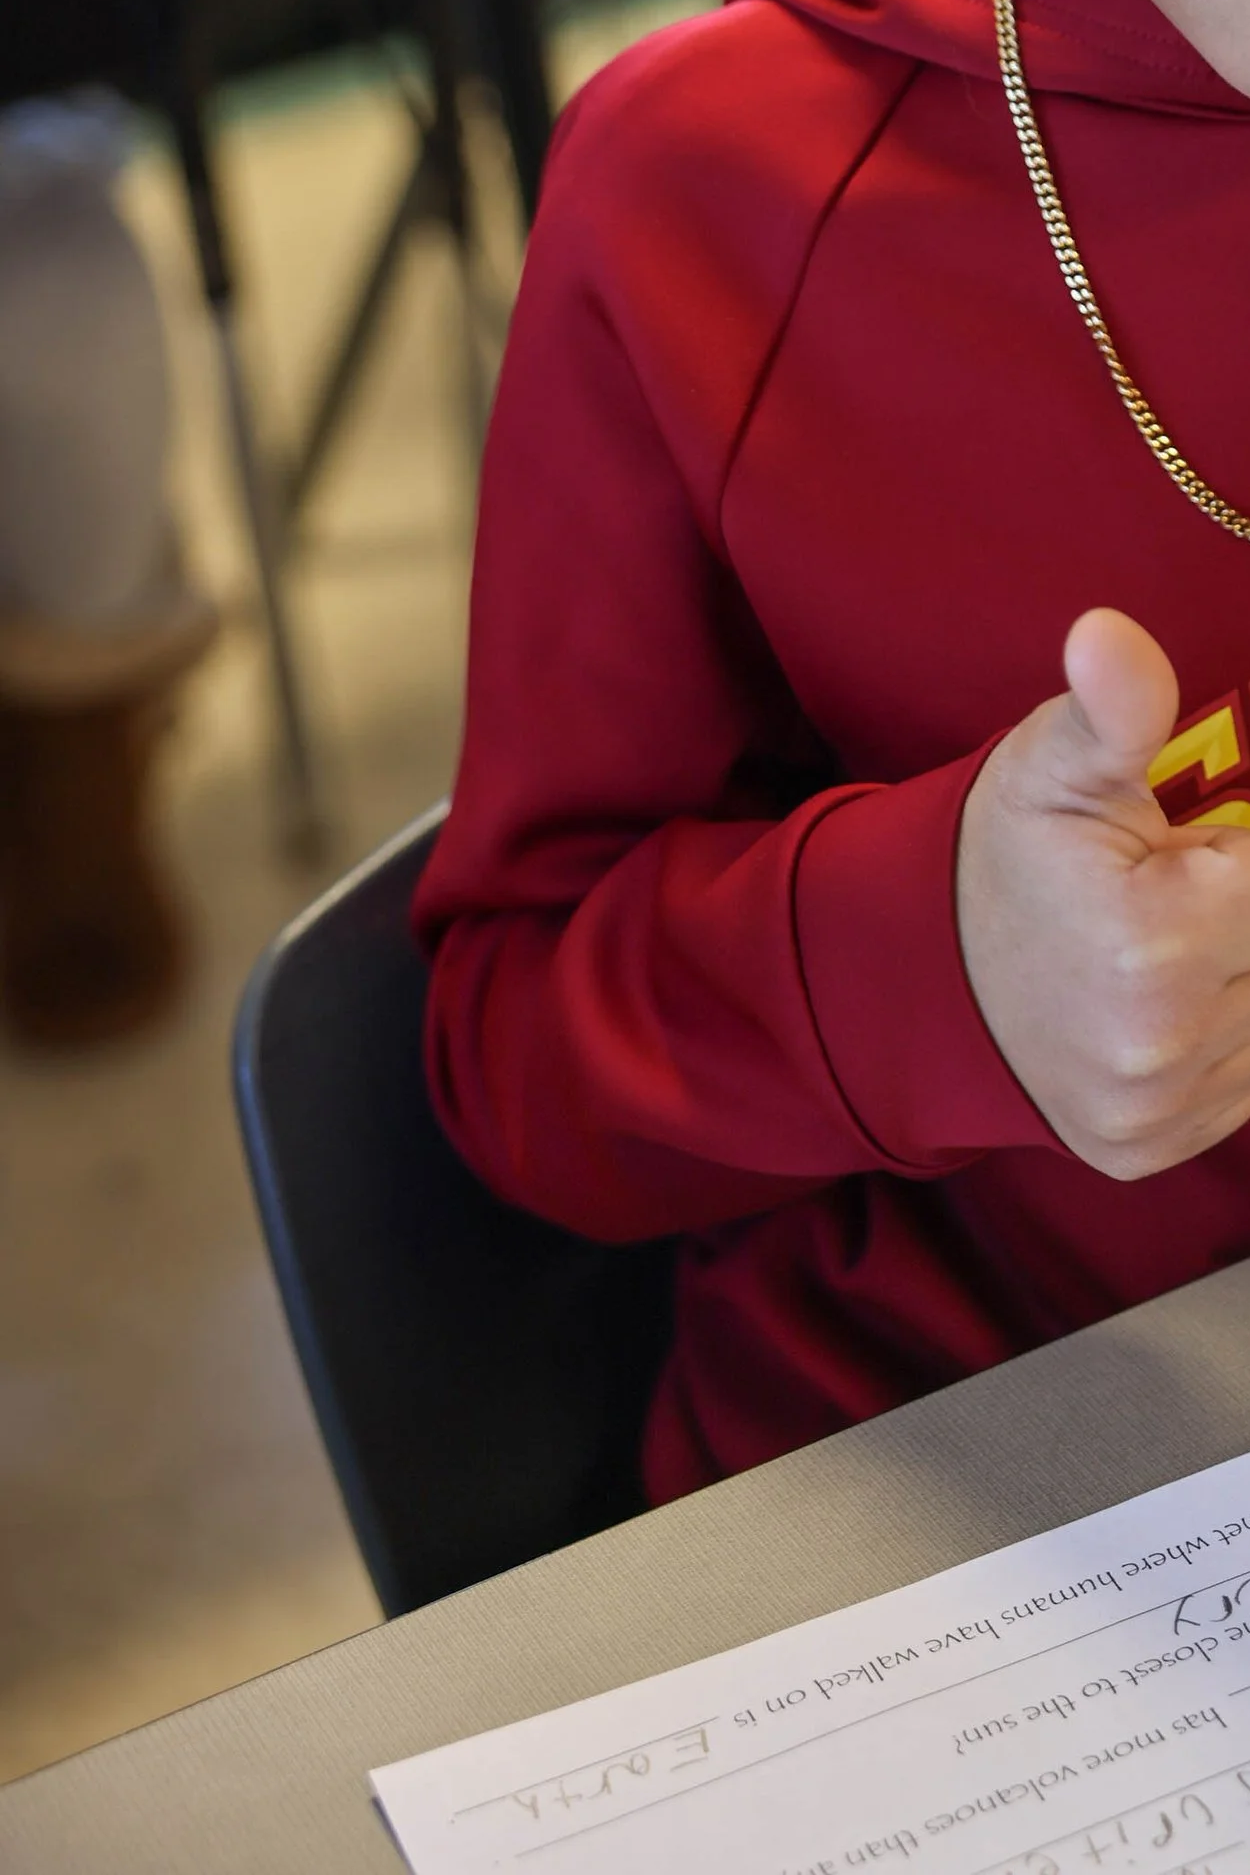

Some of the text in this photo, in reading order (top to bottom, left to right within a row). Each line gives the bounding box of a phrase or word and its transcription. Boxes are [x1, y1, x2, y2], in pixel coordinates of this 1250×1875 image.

[1120, 1536, 1211, 1577] where
[1000, 1570, 1124, 1626] humans
[924, 1618, 1001, 1654] have
[812, 1647, 920, 1701] walked
[1119, 1636, 1219, 1687] closest
[765, 1689, 807, 1714] on
[1022, 1694, 1076, 1722] the
[1081, 1677, 1118, 1699] to
[733, 1708, 758, 1728] is
[954, 1713, 1019, 1756] sun?
[1171, 1706, 1228, 1735] has
[1082, 1728, 1167, 1771] more
[512, 1725, 711, 1821] Earth
[923, 1764, 1079, 1836] volcanoes
[844, 1829, 920, 1867] than
